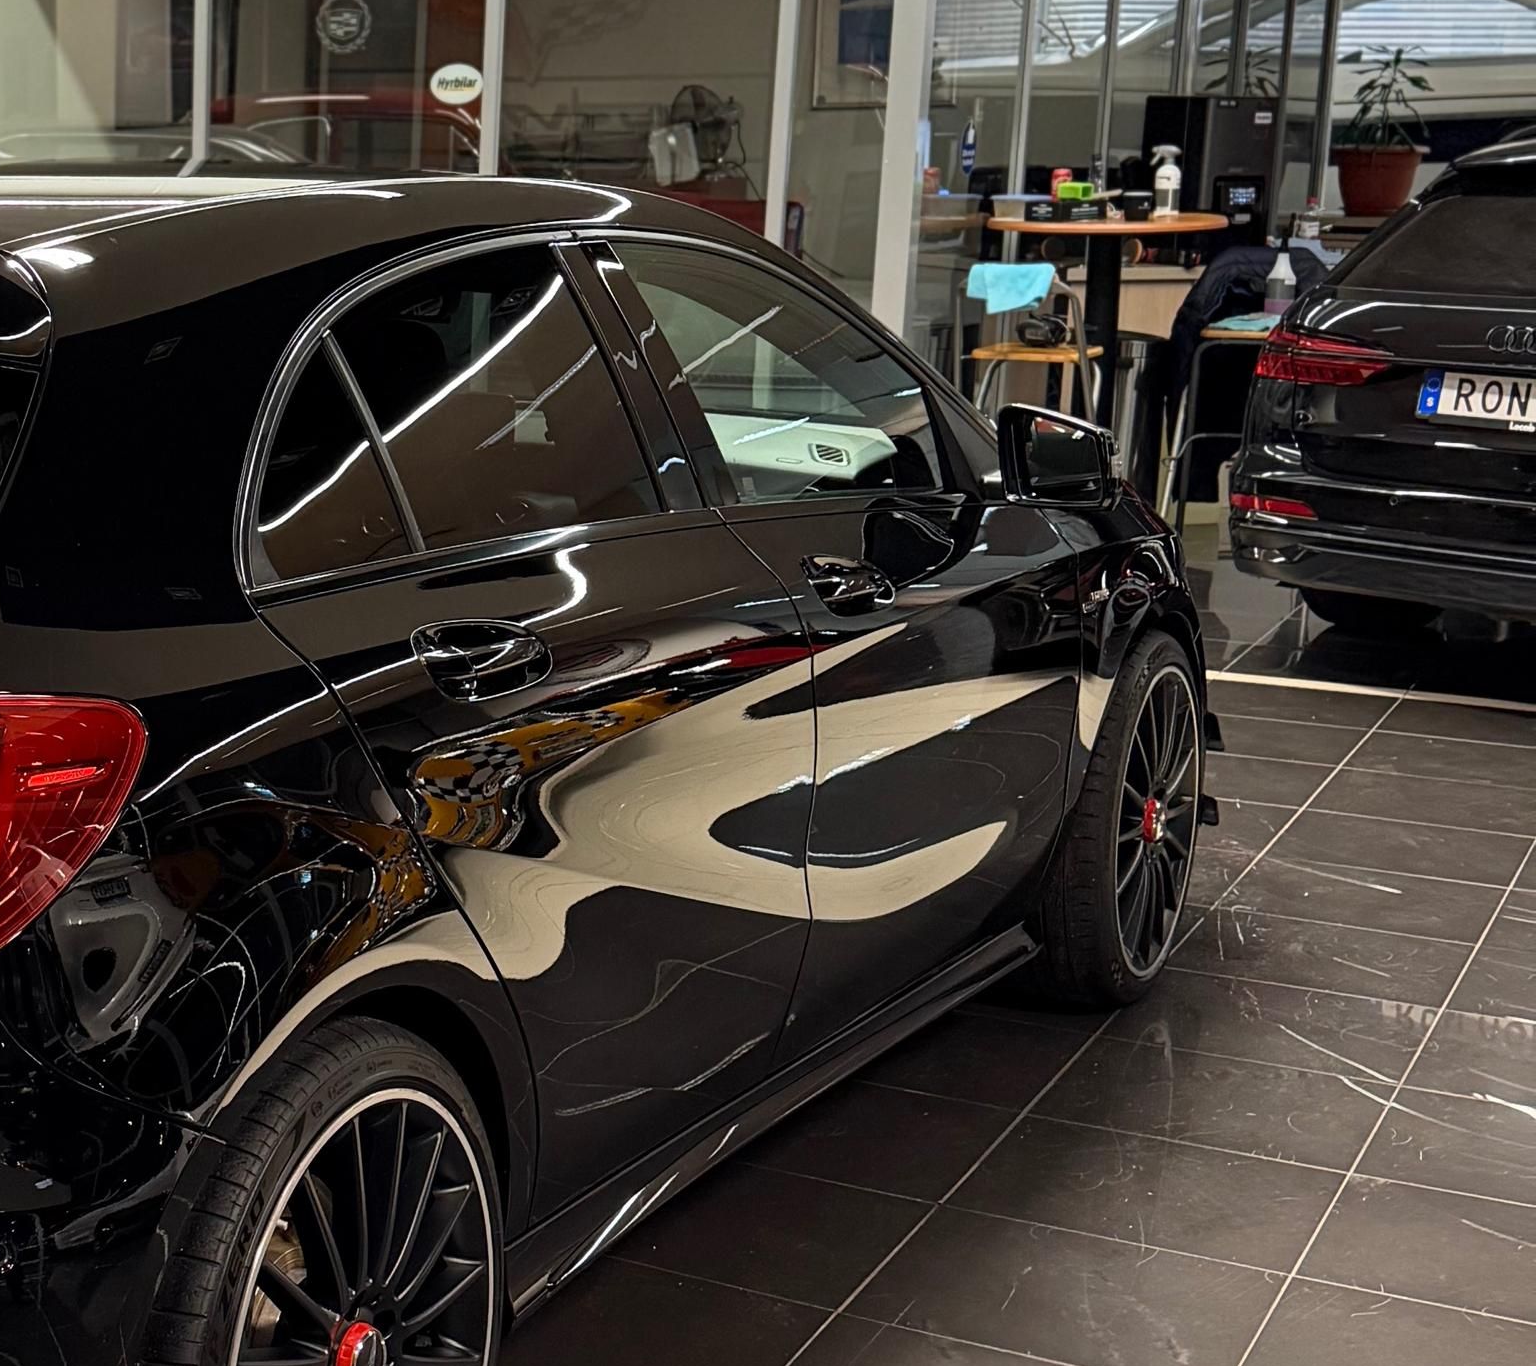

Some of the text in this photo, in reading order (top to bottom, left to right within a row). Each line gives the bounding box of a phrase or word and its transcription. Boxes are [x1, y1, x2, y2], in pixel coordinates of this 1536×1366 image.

[436, 76, 478, 91] Hyrbilar
[1426, 396, 1435, 407] S
[1453, 377, 1533, 417] RON
